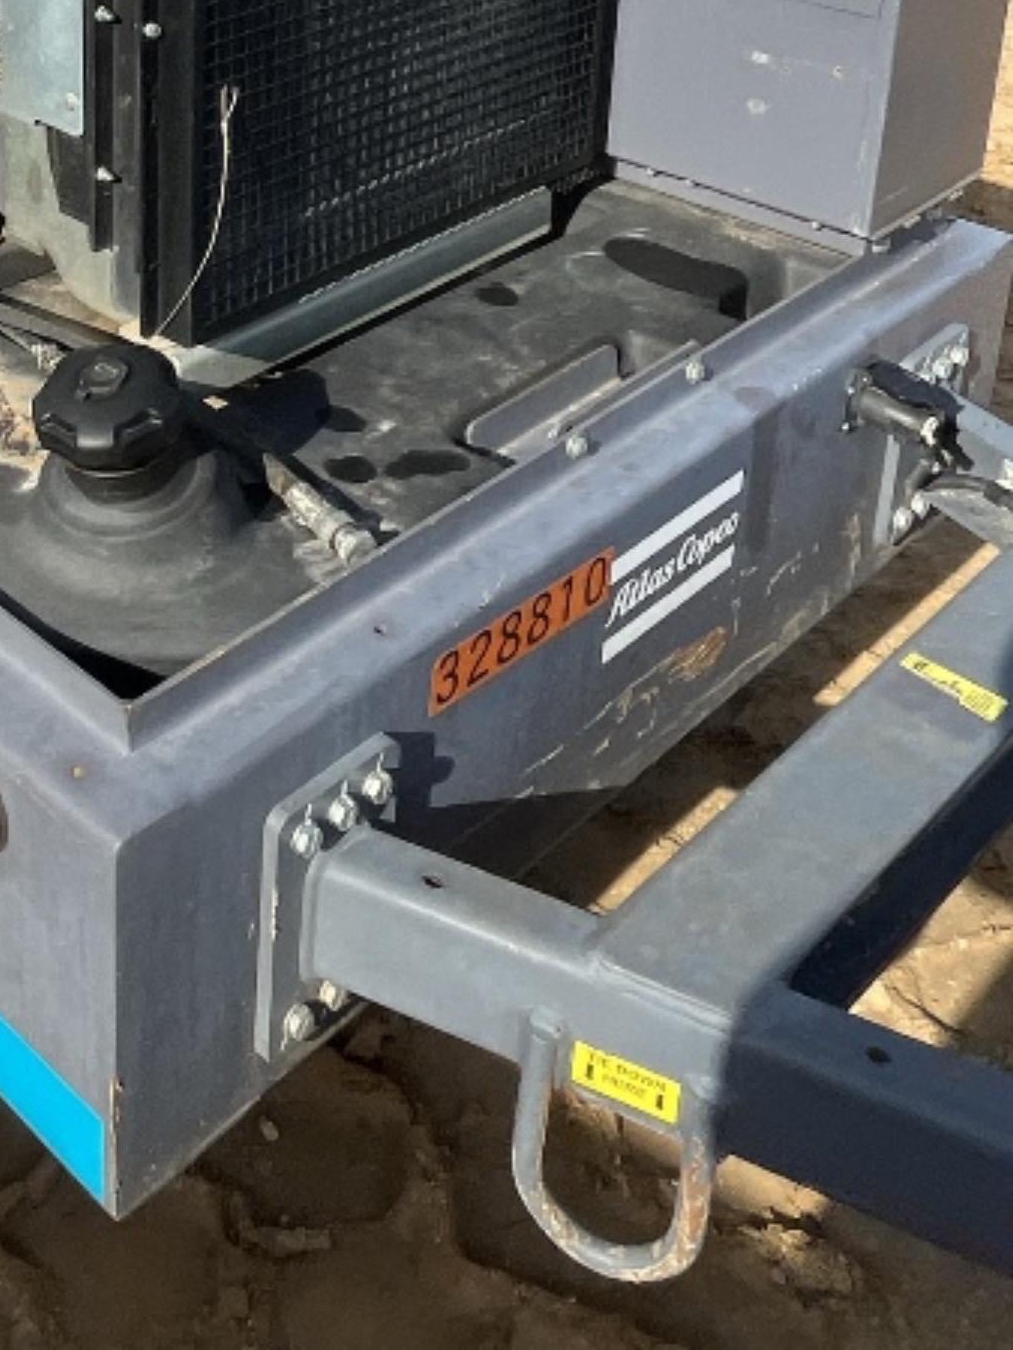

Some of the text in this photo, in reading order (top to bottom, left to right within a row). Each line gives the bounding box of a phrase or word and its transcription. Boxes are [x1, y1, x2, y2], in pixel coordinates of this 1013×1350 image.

[436, 557, 607, 703] 328810
[605, 512, 739, 628] Atlas Copco
